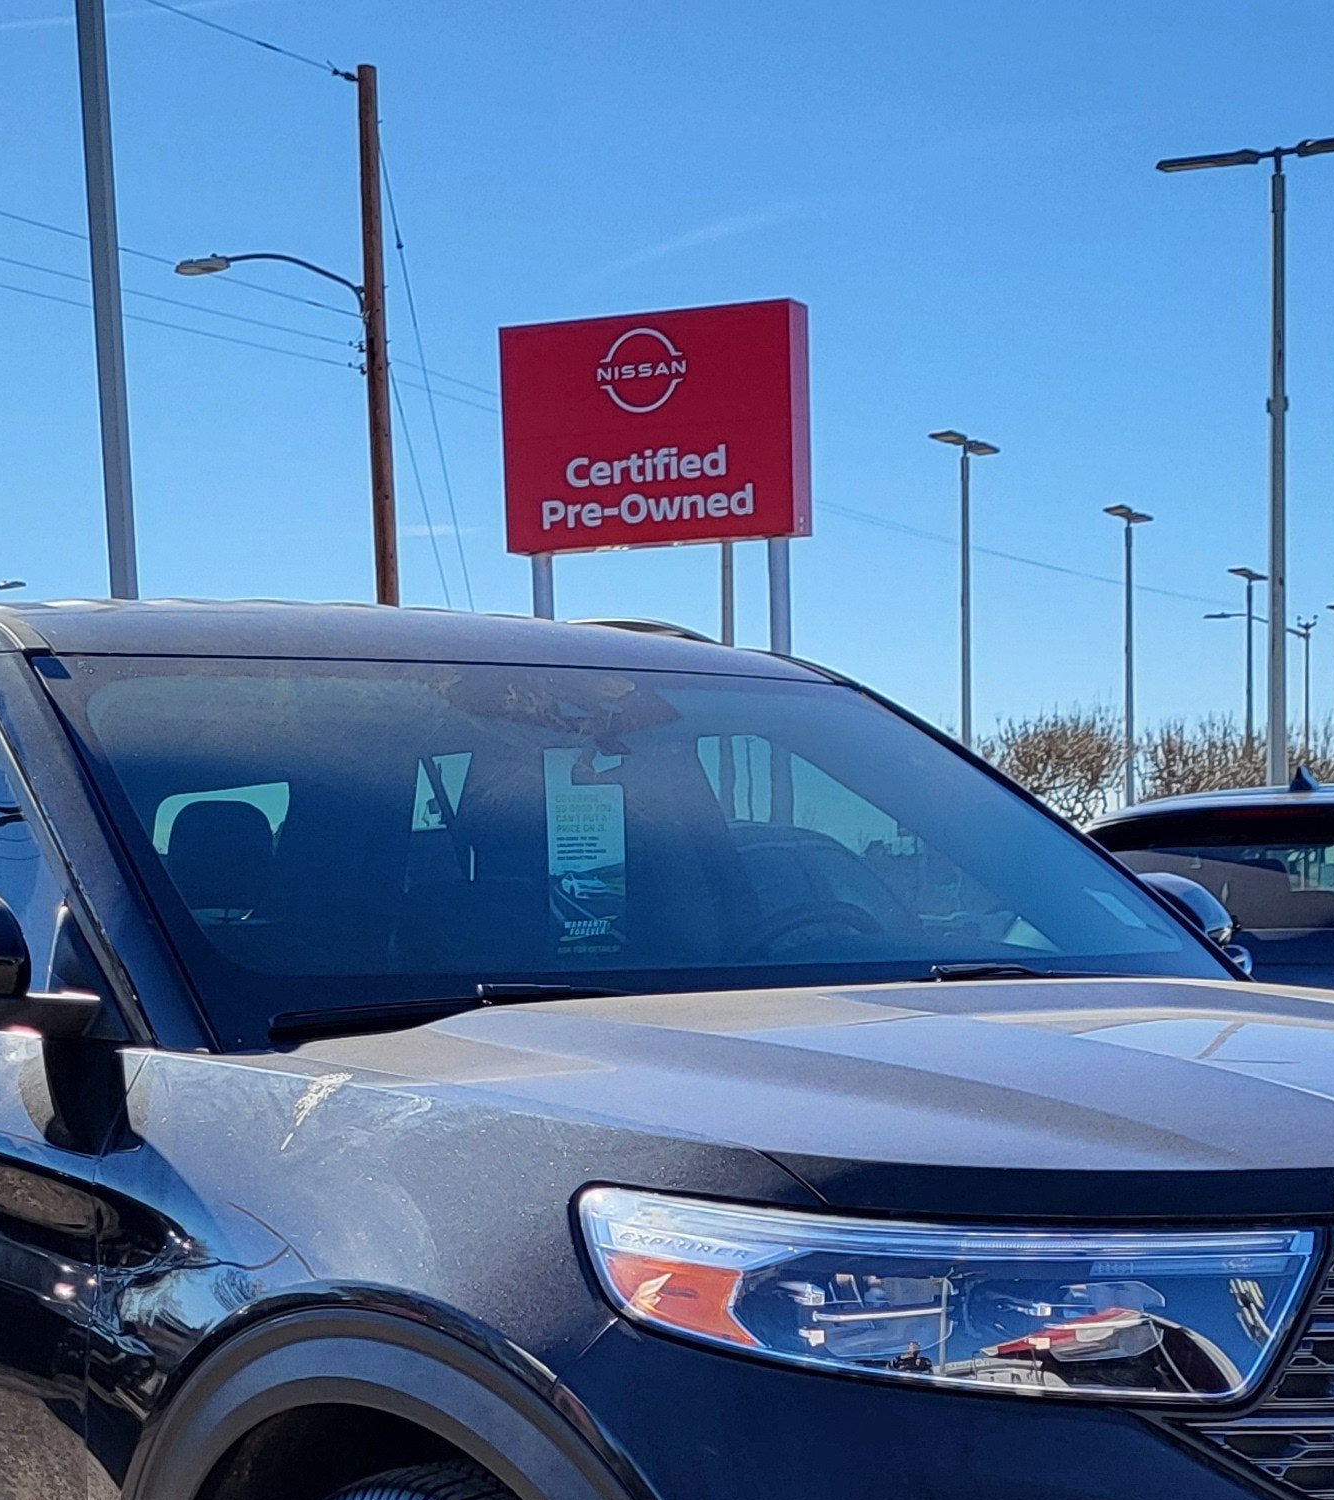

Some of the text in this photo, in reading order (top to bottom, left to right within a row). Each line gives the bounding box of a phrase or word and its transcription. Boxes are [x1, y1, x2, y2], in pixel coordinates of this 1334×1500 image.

[597, 359, 687, 382] NISSAN
[566, 444, 727, 488] Certified
[542, 483, 754, 530] Pre-Owned
[619, 1231, 749, 1260] EXPLORER
